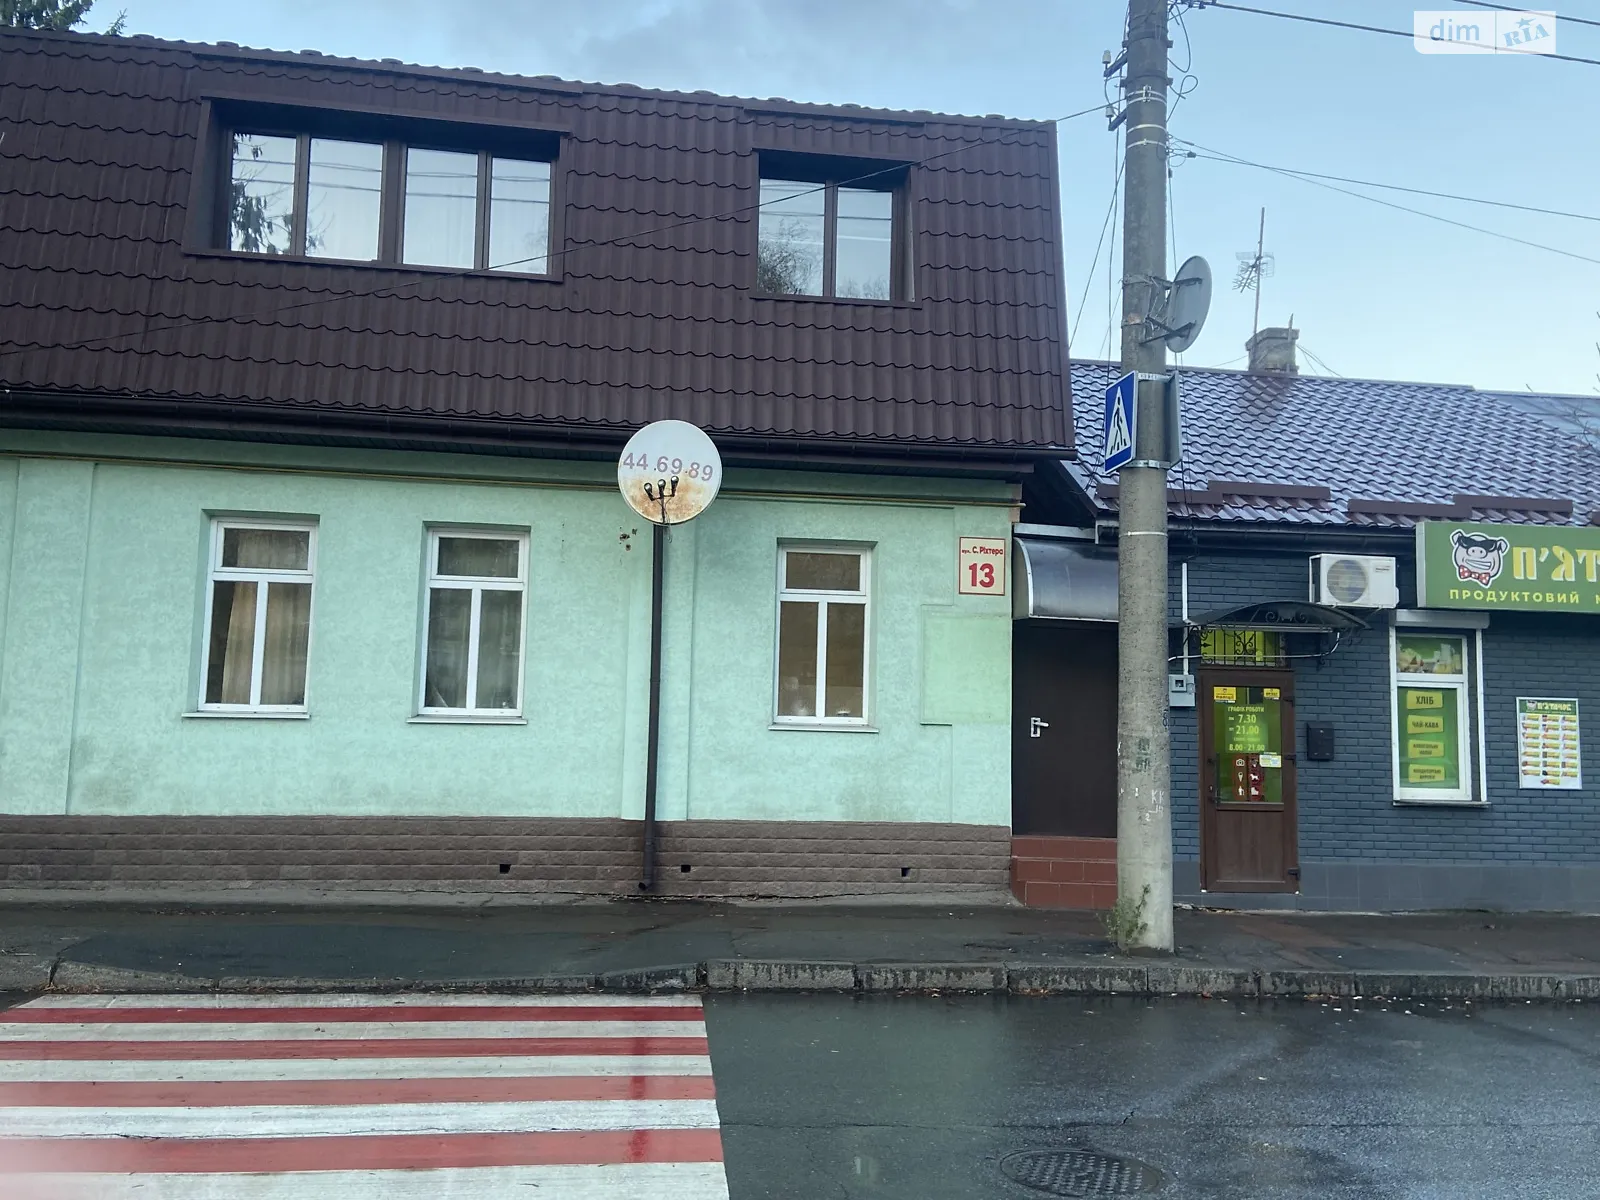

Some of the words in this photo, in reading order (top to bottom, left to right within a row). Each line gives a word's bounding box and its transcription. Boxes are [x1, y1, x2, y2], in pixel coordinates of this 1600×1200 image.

[968, 563, 995, 588] 13
[1450, 589, 1580, 604] ПРОДУКТОВИЙ
[1416, 696, 1434, 705] ХЛІБ
[1238, 714, 1256, 723] 7.30
[1236, 725, 1259, 735] 21.00
